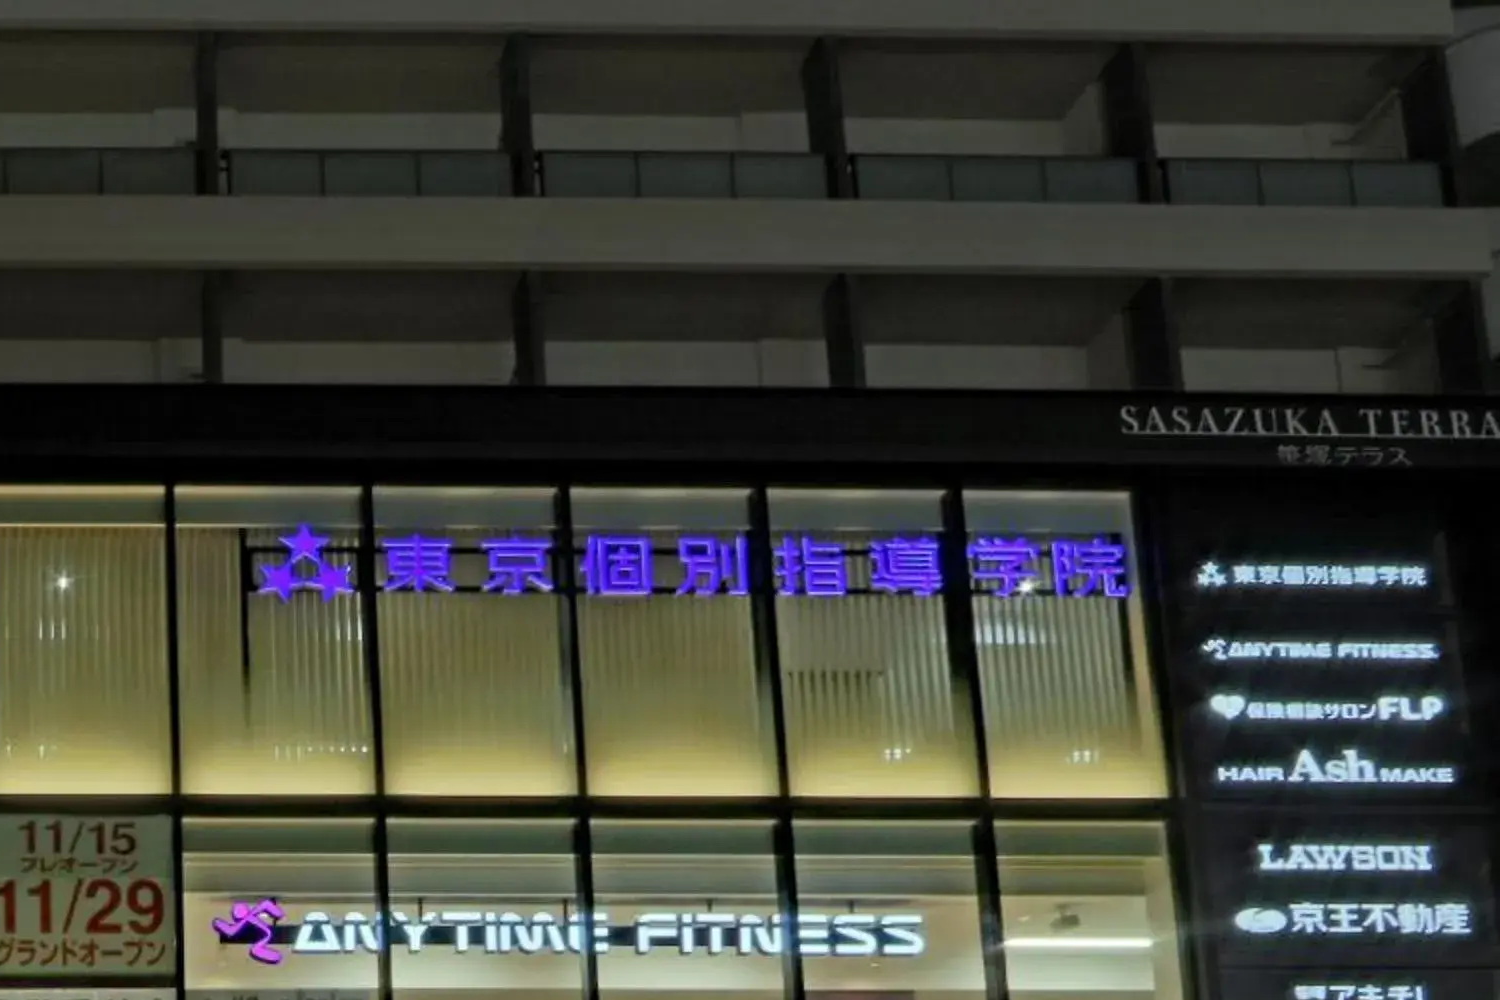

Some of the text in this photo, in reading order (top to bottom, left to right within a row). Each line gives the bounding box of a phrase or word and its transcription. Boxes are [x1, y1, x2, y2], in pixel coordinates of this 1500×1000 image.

[1120, 405, 1339, 436] SASAZUKA
[381, 534, 1129, 597] 東京個別指導学院
[1228, 642, 1440, 660] ANYTIME FITNESS
[1218, 750, 1454, 783] HAIR Ash MAKE
[17, 820, 136, 856] 11/15
[1257, 845, 1433, 871] LAWSON
[292, 909, 927, 957] ANYTIME FITNESS
[1288, 902, 1472, 934] 京王不動産
